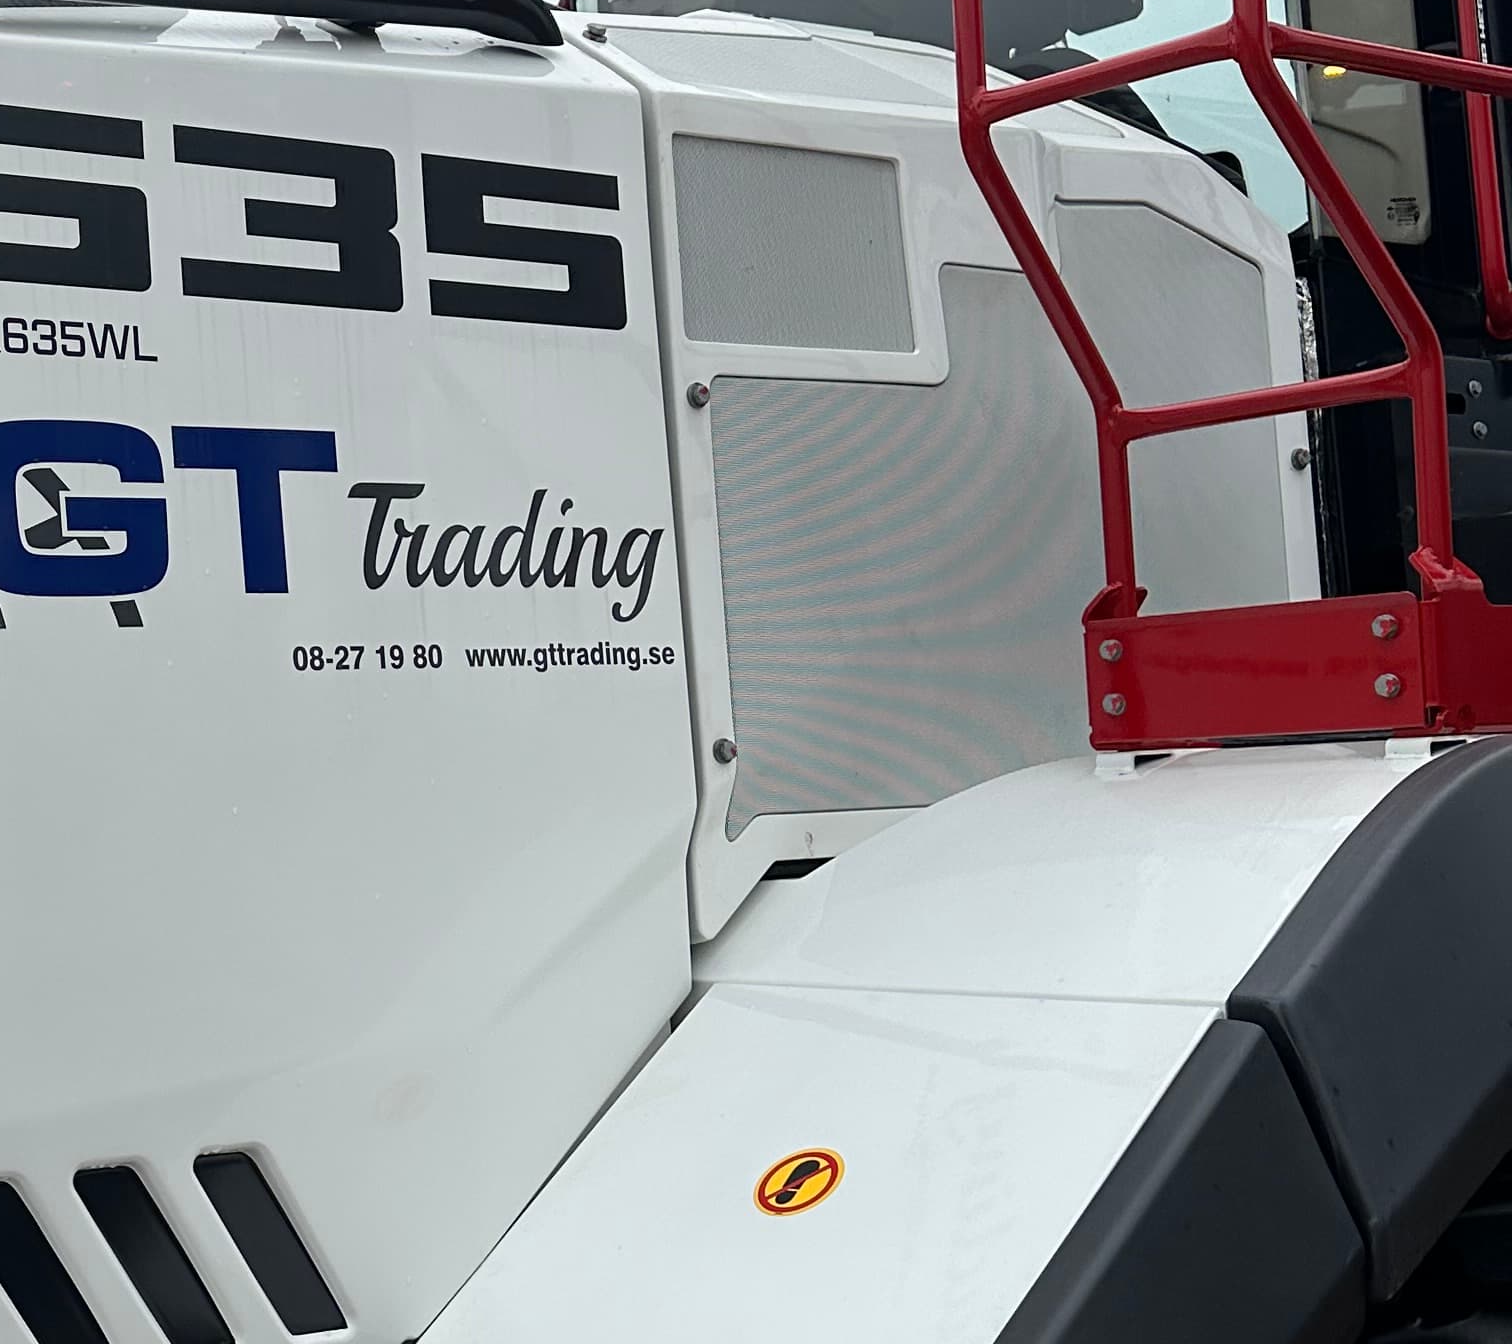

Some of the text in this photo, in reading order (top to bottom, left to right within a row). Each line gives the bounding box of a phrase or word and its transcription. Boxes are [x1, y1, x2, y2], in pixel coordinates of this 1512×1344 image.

[346, 481, 666, 624] Trading
[291, 640, 676, 674] 08-27 19 80 www.gttrading.se
